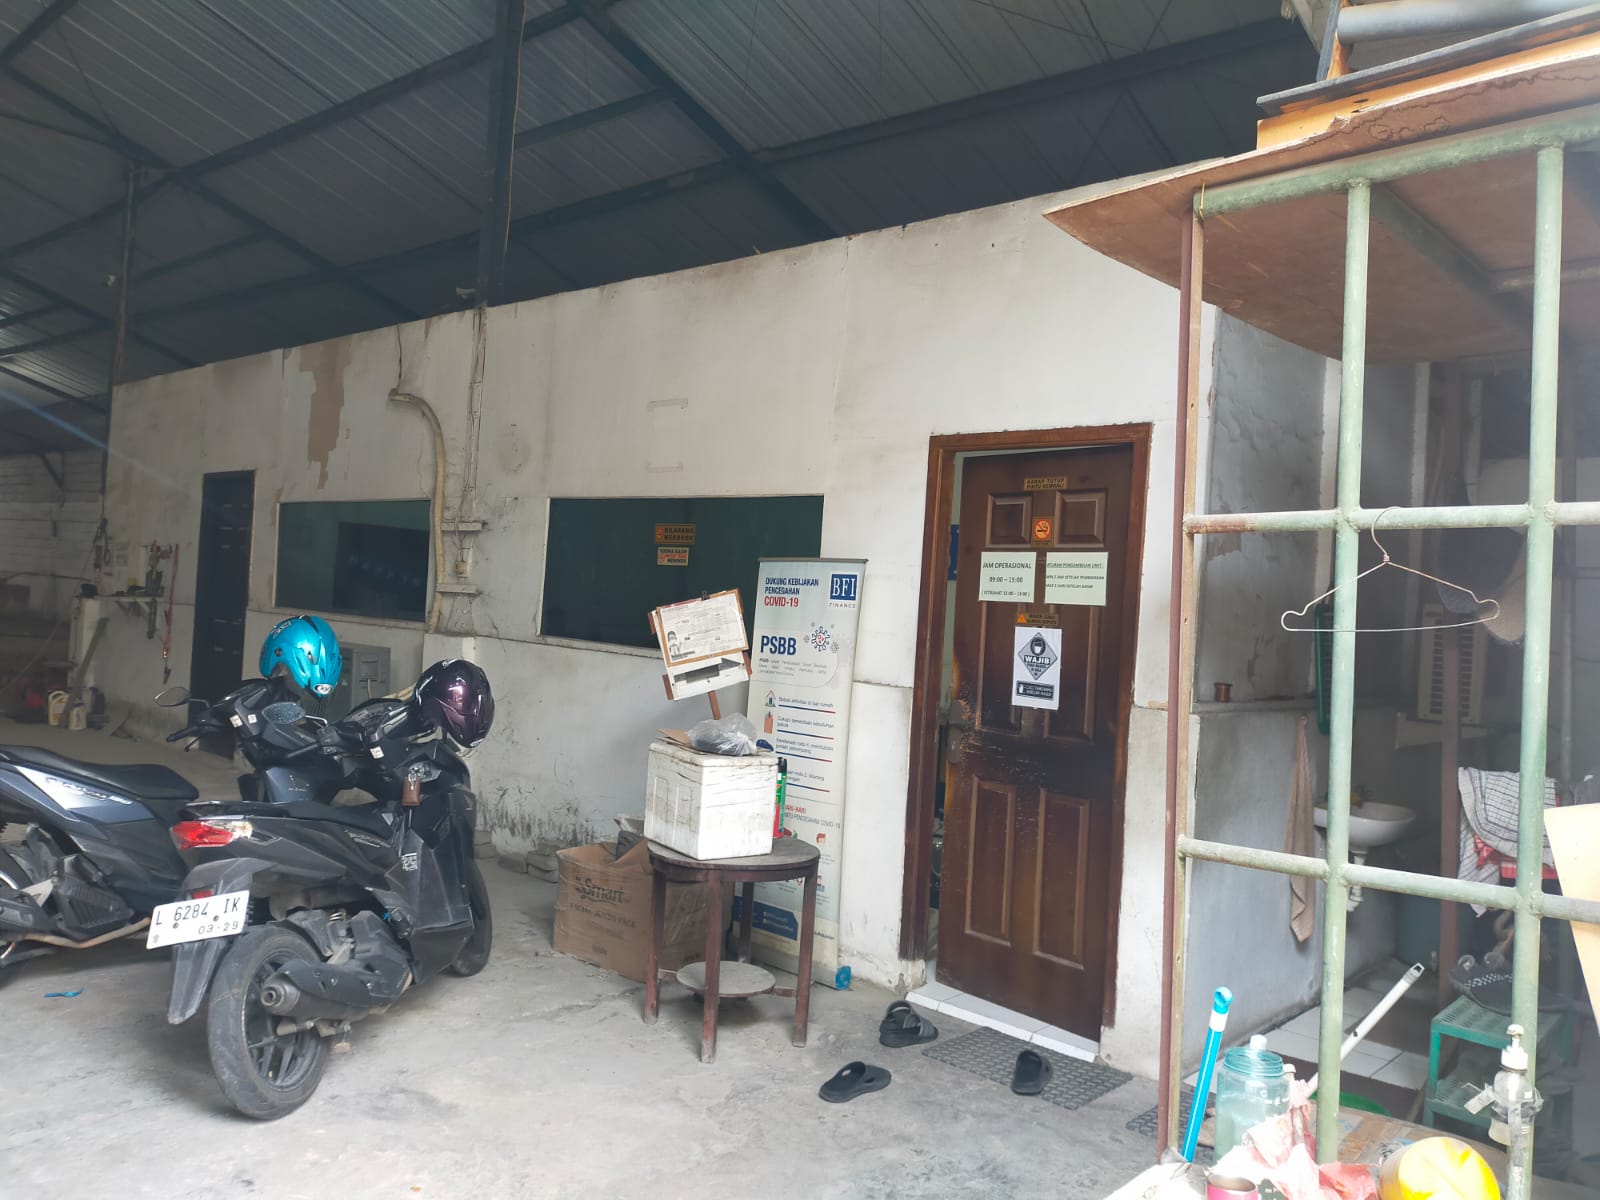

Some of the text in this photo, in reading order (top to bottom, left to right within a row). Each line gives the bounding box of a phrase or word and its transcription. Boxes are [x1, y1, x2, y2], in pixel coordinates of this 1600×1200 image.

[765, 577, 820, 587] DUKUNG KEBIJAKAN
[832, 577, 856, 597] BFI
[764, 586, 800, 595] PENCEGAHAN
[763, 596, 799, 608] COVID-19
[760, 635, 797, 656] PSBB
[1025, 655, 1050, 665] WAJIB
[156, 897, 241, 926] L 6284 IK
